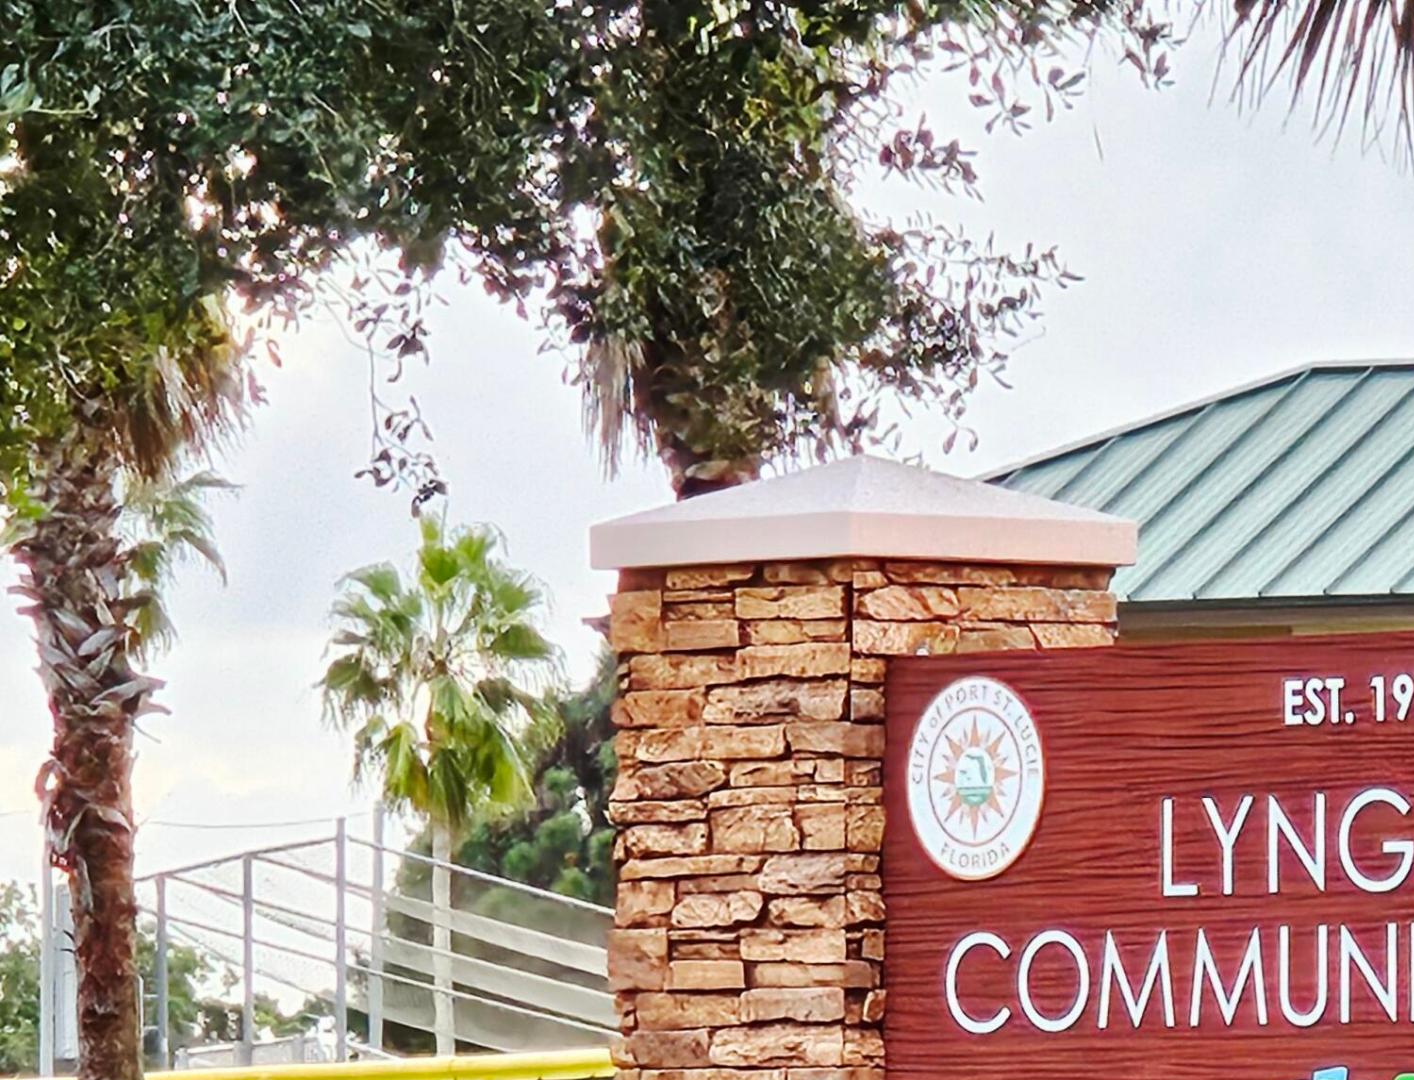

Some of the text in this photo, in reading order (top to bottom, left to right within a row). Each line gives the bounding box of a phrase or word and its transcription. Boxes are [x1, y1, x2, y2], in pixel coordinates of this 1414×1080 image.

[1283, 676, 1355, 727] EST.
[911, 684, 1041, 786] CITY of PORT ST. LUCIE
[939, 841, 1012, 869] FLORIDA
